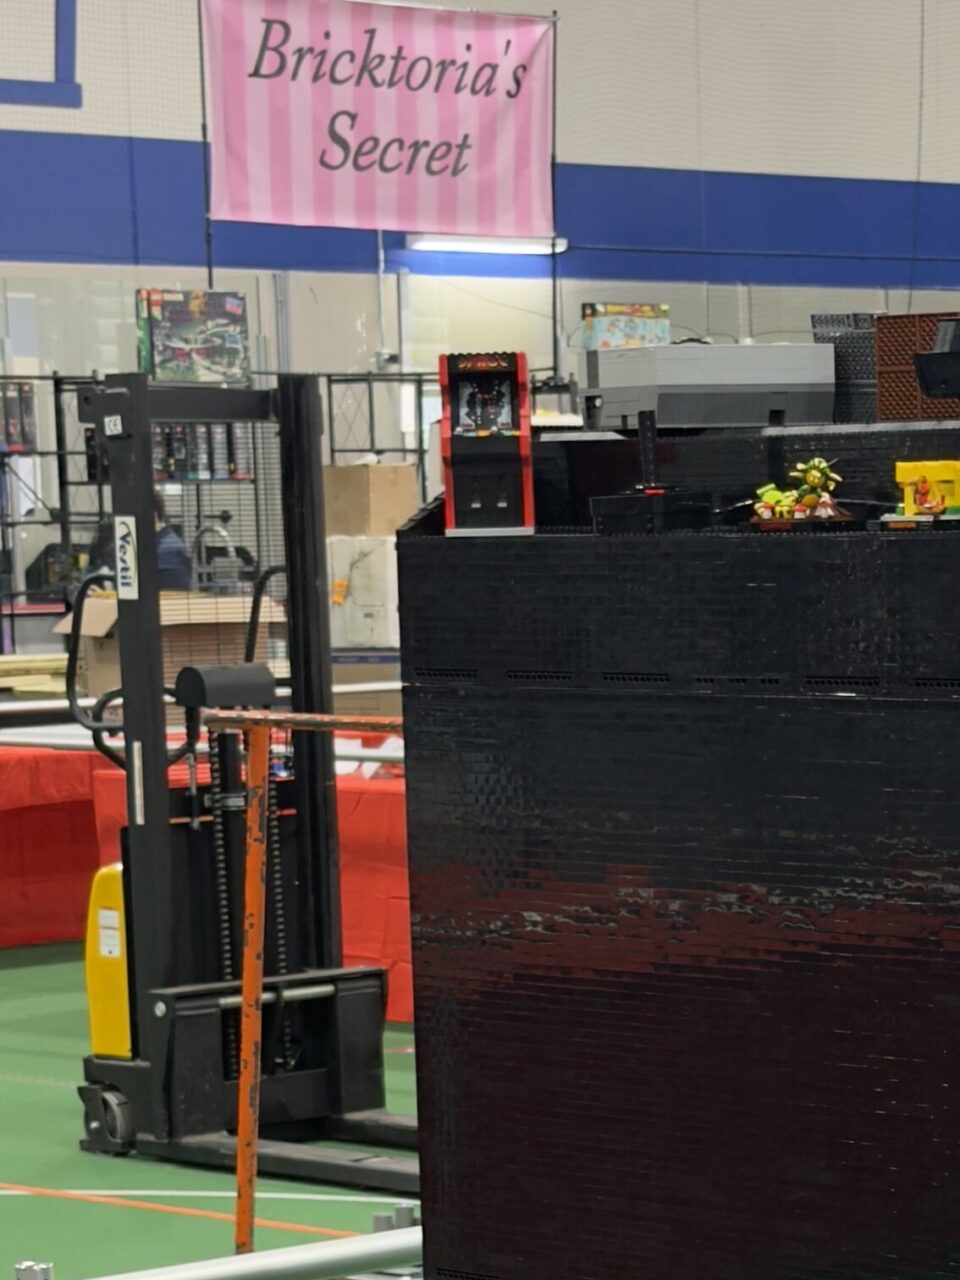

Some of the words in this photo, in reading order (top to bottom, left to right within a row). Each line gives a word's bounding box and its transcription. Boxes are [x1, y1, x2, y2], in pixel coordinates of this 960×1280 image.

[249, 18, 528, 99] Bricktoria's
[319, 110, 472, 178] Secret
[118, 531, 132, 588] Vestil
